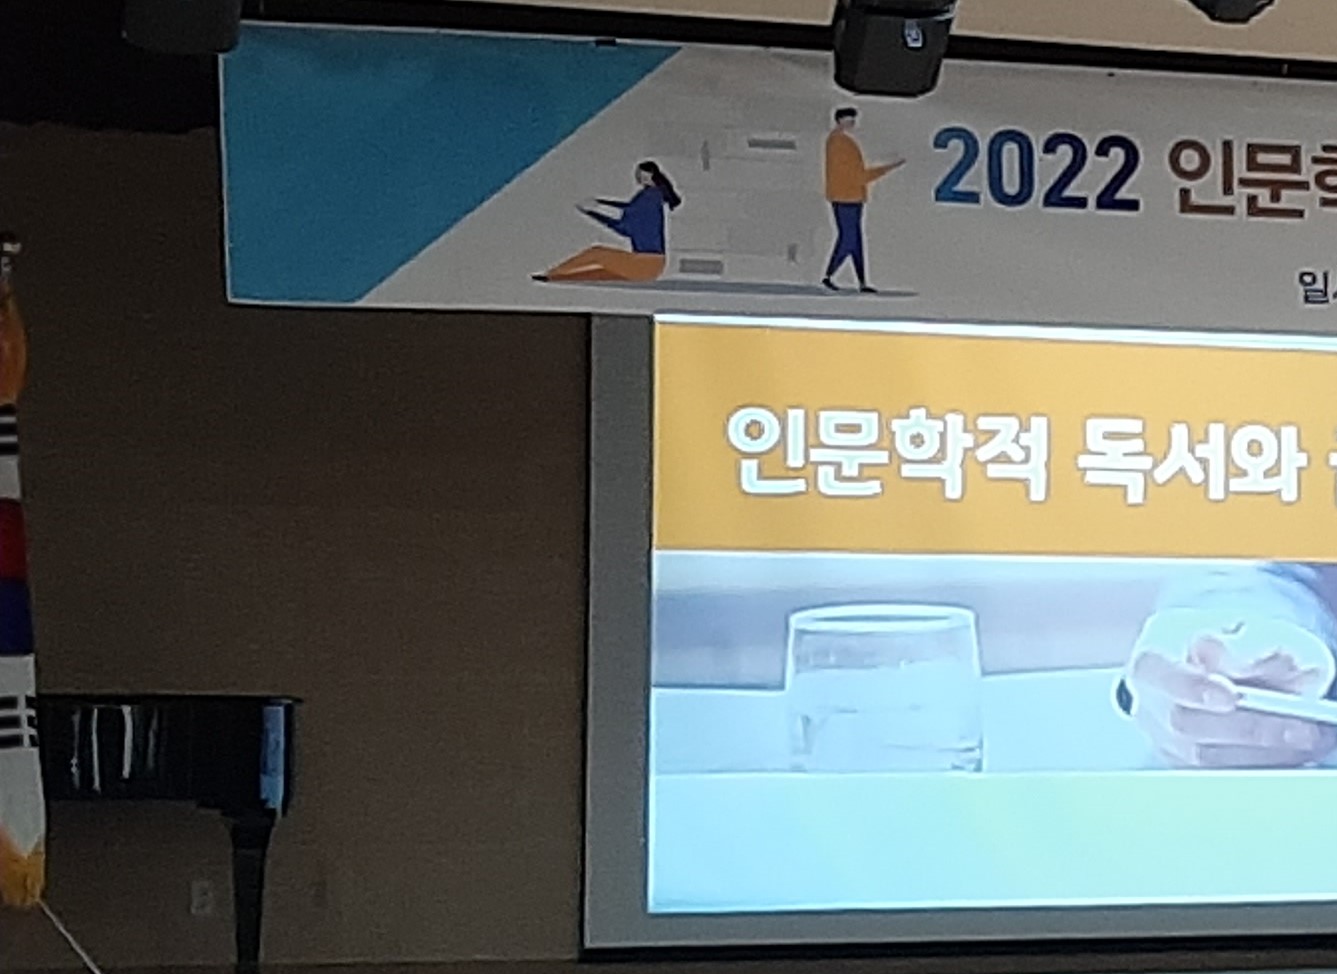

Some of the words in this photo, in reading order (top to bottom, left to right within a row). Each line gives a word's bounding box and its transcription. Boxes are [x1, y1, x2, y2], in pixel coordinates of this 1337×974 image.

[932, 126, 1141, 212] 2022
[727, 406, 1051, 502] 인문학적
[1076, 420, 1307, 505] 독서와
